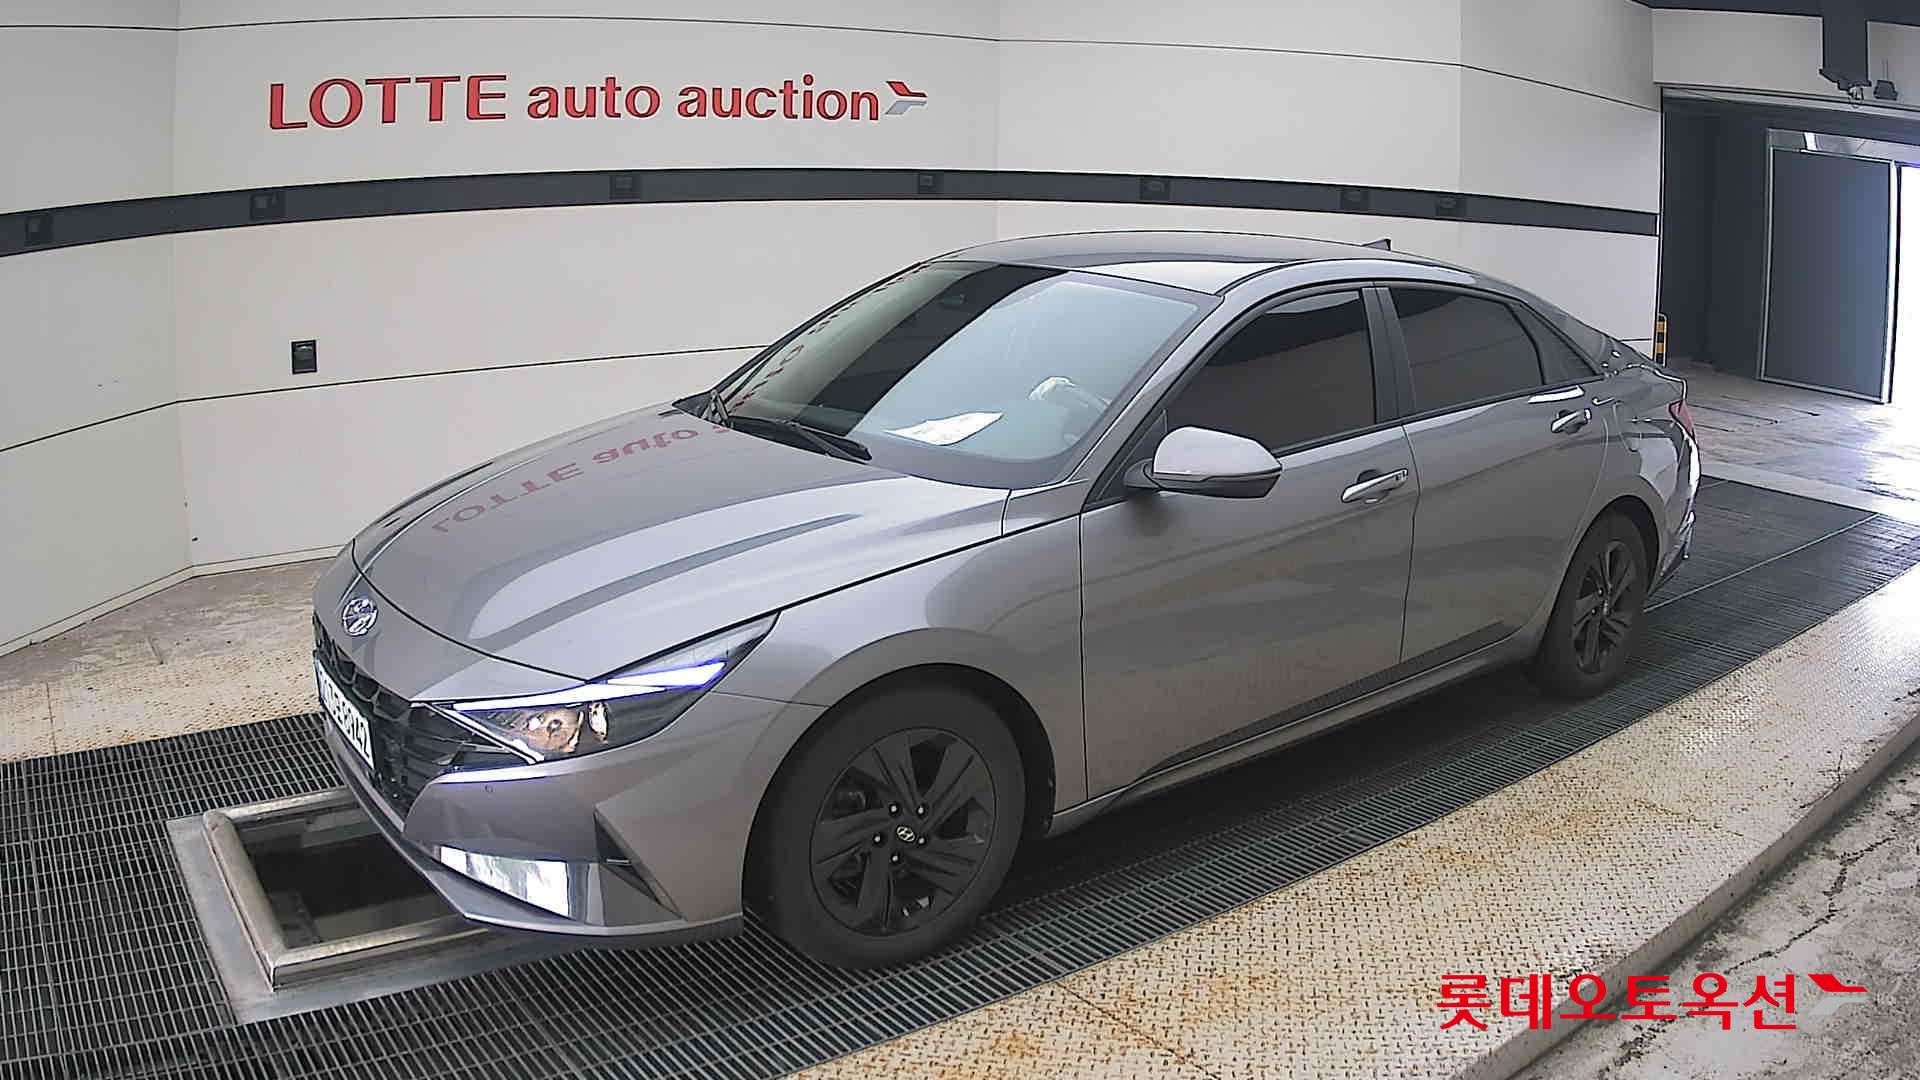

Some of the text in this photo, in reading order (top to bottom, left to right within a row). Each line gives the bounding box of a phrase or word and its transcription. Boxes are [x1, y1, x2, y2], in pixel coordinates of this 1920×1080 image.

[268, 74, 881, 130] LOTTE auto auction
